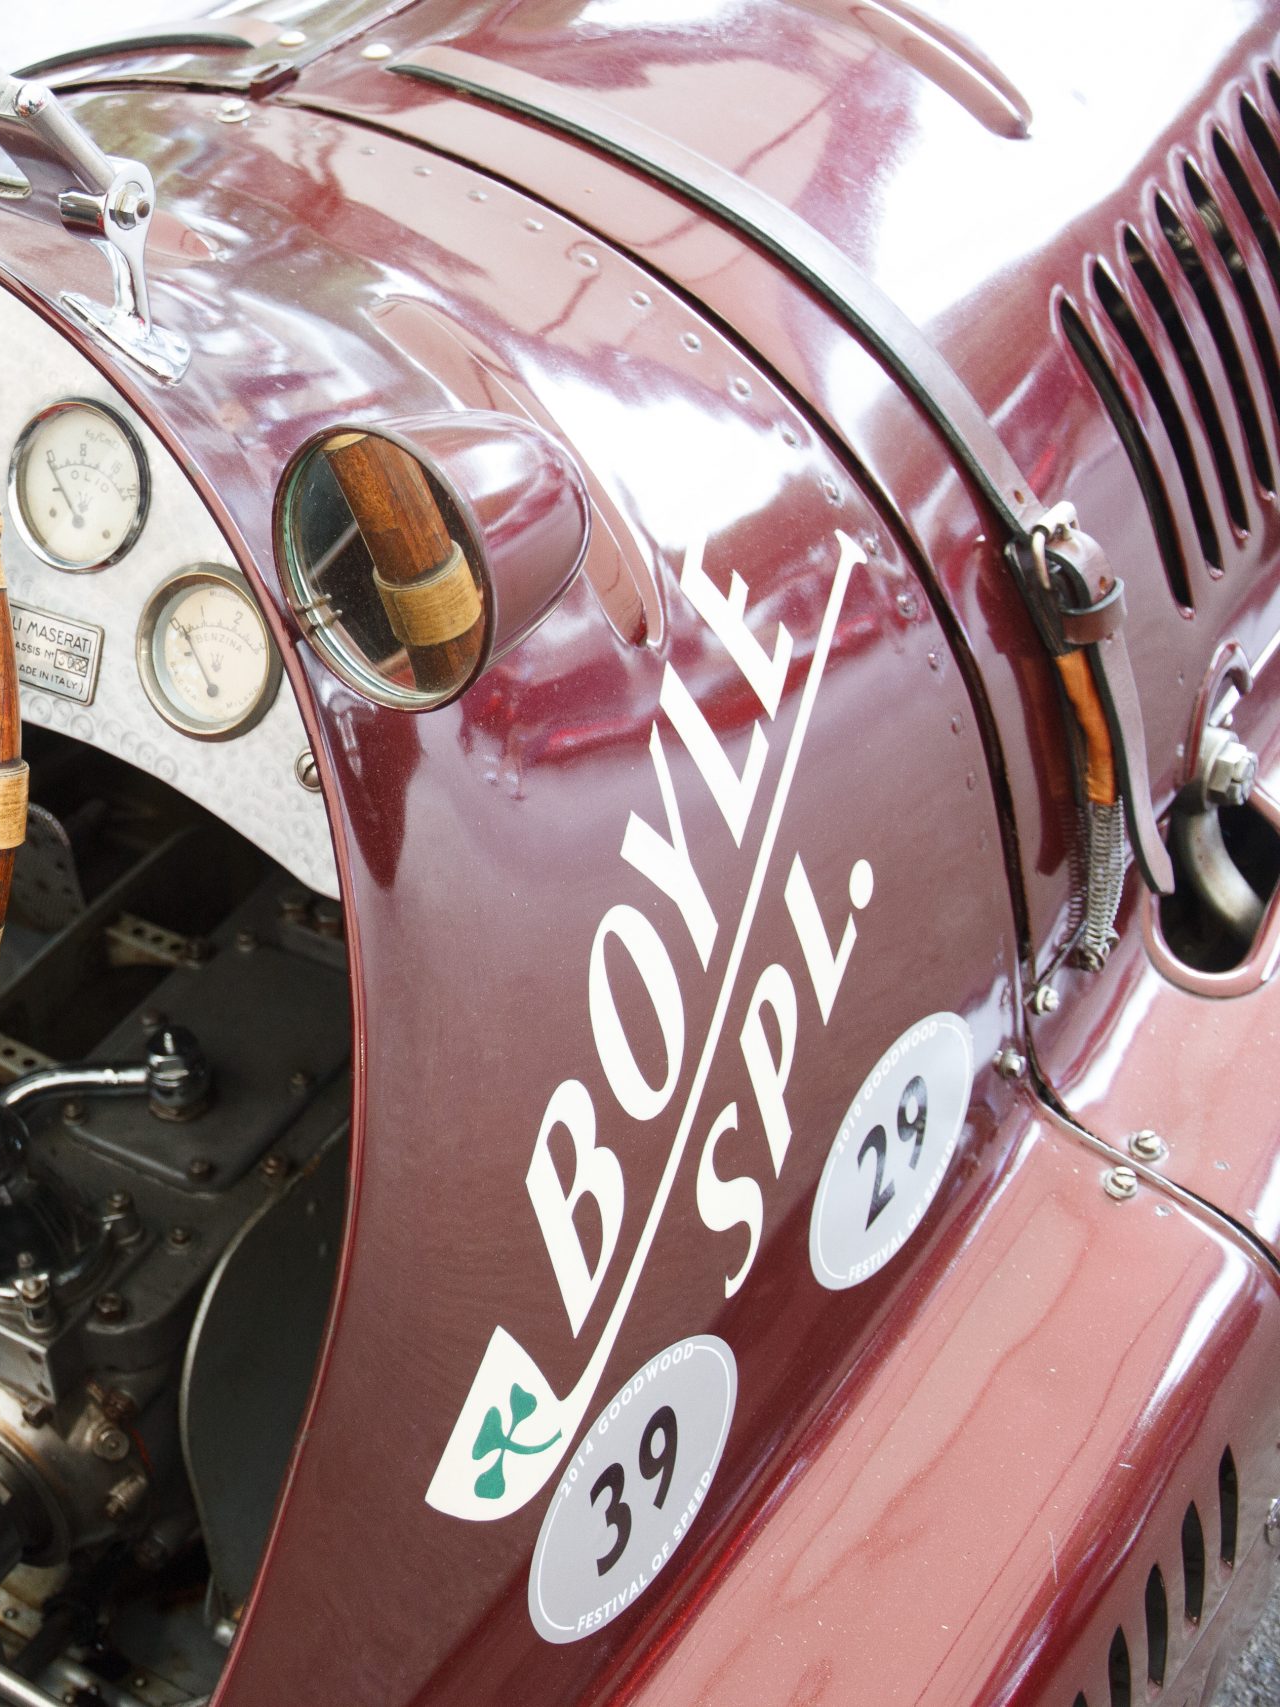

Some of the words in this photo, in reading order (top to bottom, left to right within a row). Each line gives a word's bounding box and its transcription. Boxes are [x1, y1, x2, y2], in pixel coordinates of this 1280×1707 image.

[70, 469, 110, 494] OLIO
[15, 641, 41, 657] ASSIS
[18, 663, 38, 677] ADE
[39, 670, 50, 681] IN
[26, 620, 93, 654] MASERATI
[196, 631, 243, 651] BENZINA
[233, 610, 244, 626] 2
[525, 532, 794, 1338] BOYLE
[696, 851, 874, 1298] SPL.
[834, 1102, 862, 1157] 2010
[863, 1020, 939, 1101] GOODWOOD
[847, 1226, 907, 1282] FESTIVAL
[907, 1203, 923, 1227] OF
[923, 1137, 956, 1199] SPEED
[857, 1075, 928, 1232] 29
[560, 1438, 595, 1499] 2014
[597, 1342, 696, 1436] GOODWOOD
[590, 1405, 678, 1577] 39
[576, 1574, 648, 1633] FESTIVAL
[651, 1541, 671, 1571] OF
[672, 1471, 713, 1541] SPEED
